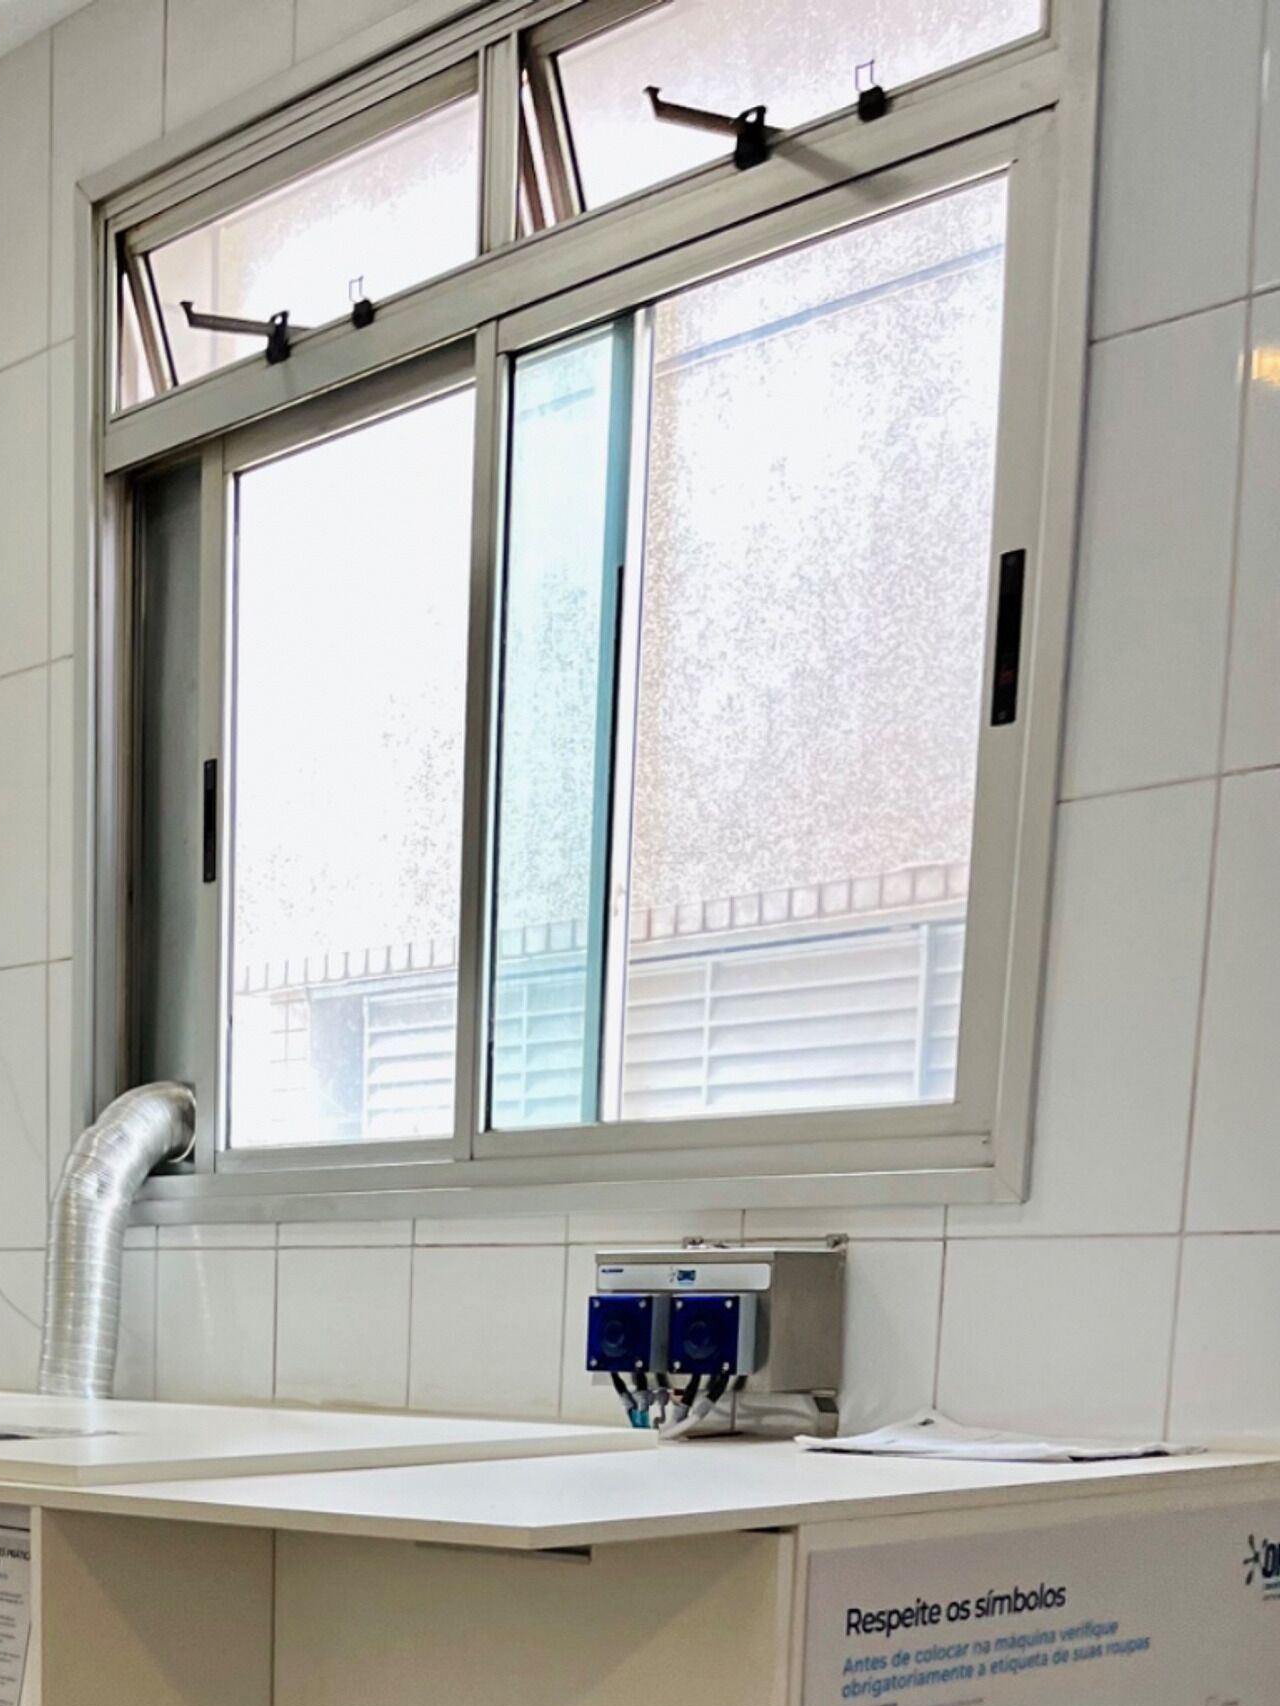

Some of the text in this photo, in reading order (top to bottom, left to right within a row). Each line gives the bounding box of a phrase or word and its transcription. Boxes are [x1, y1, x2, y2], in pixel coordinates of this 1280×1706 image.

[845, 1582, 1067, 1638] Respeite os símbolos
[841, 1635, 1151, 1698] obrigatoriamente a etiqueta de suas roupas
[842, 1620, 1119, 1676] Antes de colocar na máquina verifique
